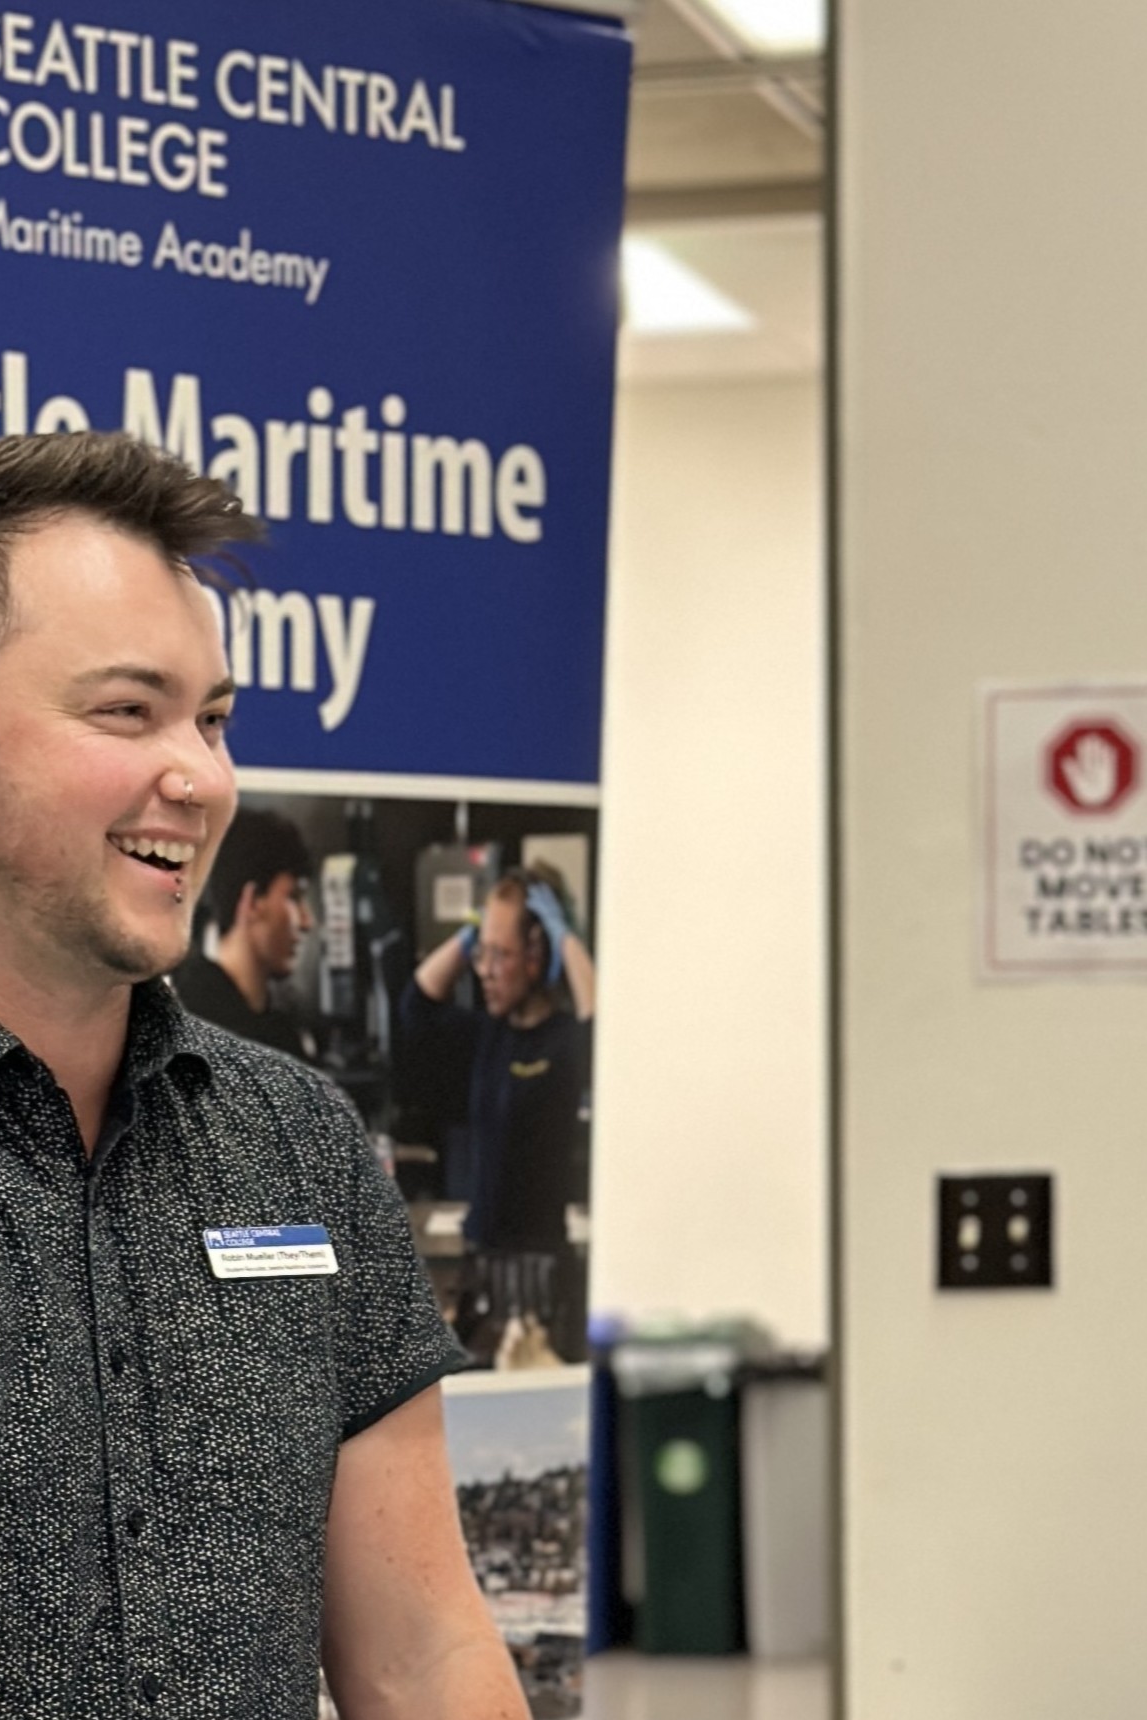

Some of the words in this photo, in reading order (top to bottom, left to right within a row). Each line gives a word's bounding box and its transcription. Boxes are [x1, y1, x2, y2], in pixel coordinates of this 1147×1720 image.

[215, 49, 466, 152] CENTRAL
[153, 221, 330, 305] Academy
[1019, 836, 1076, 868] DO
[1037, 874, 1145, 900] MOVE
